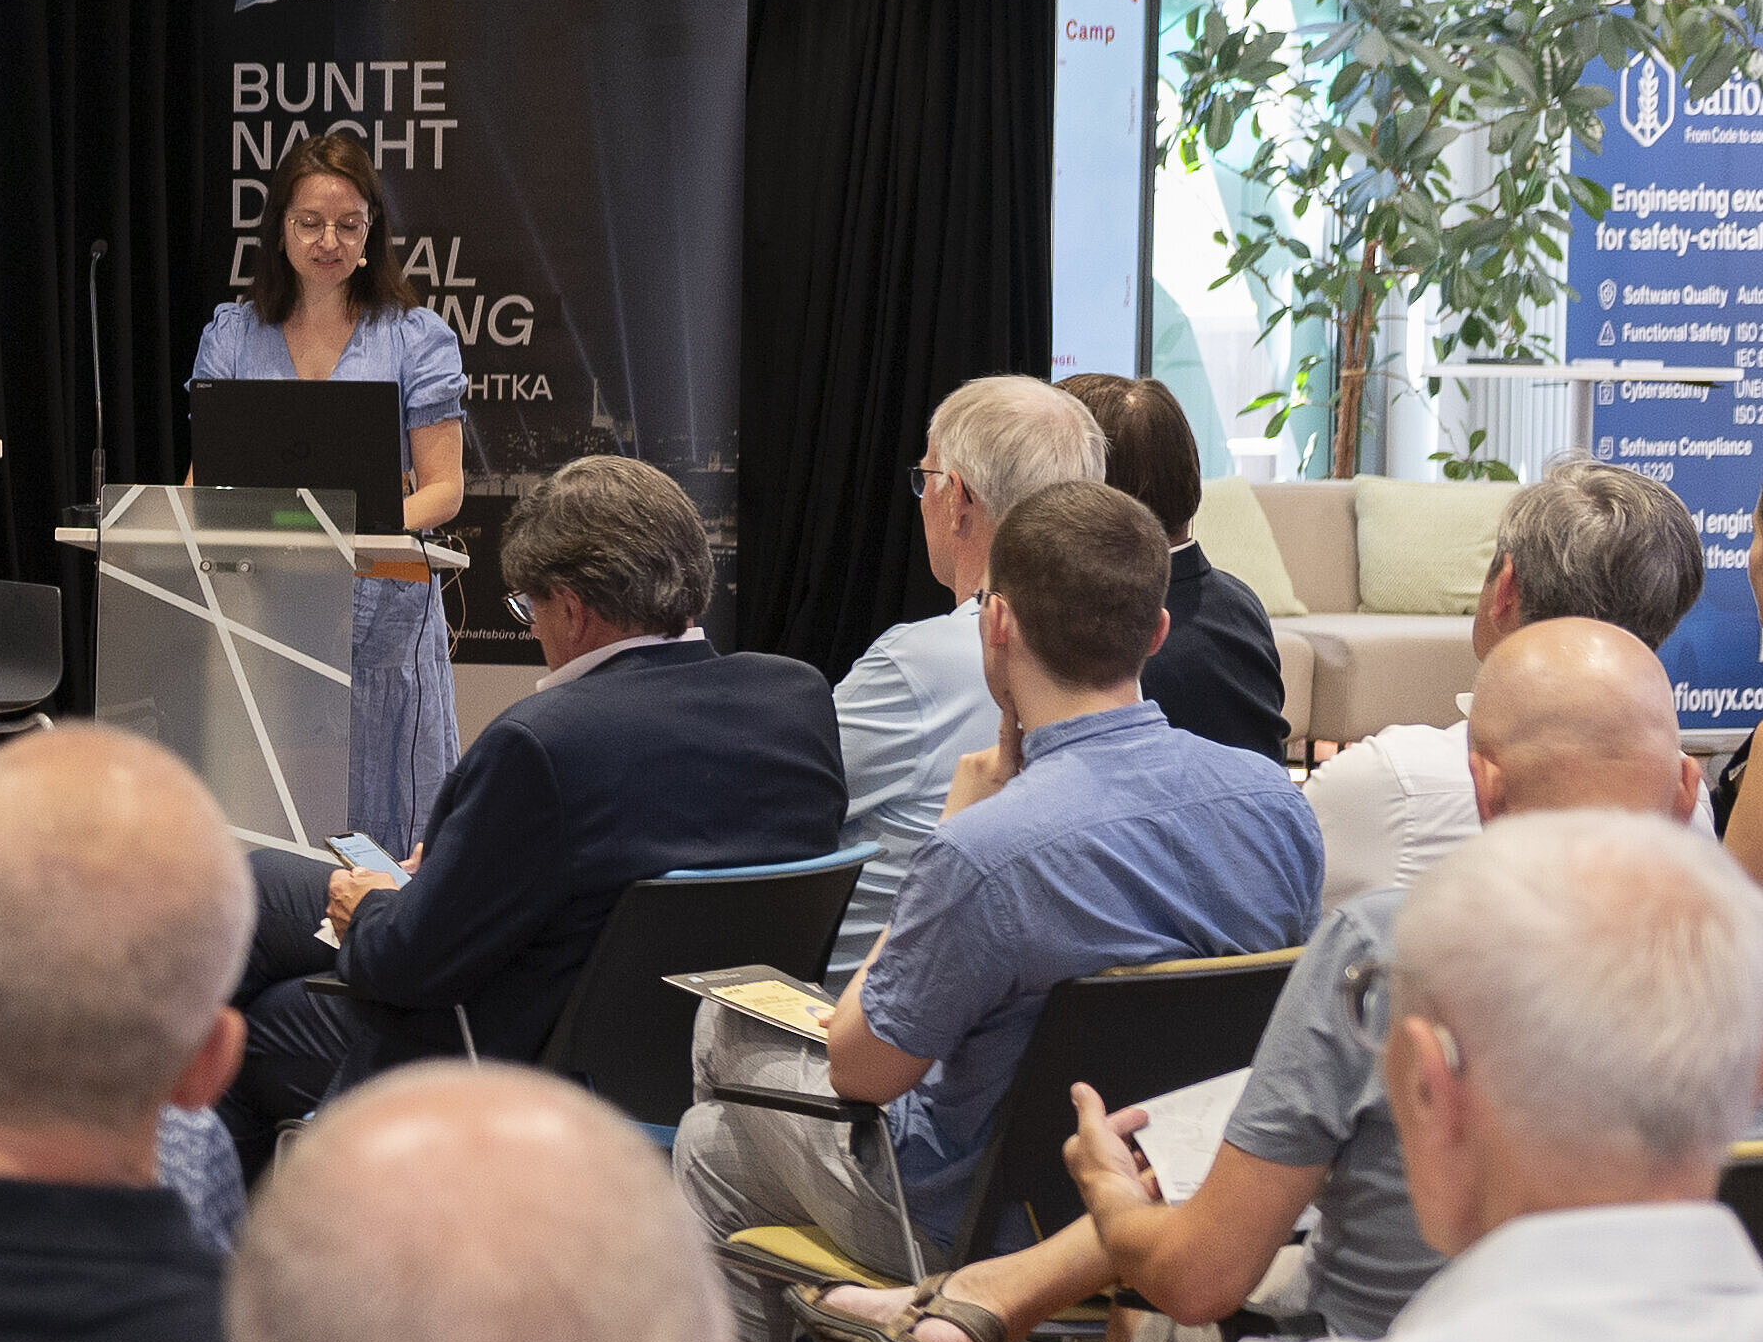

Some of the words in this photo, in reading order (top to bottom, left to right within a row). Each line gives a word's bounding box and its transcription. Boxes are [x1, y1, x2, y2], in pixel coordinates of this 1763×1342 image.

[1066, 20, 1115, 46] Camp
[233, 61, 446, 112] BUNTE
[1683, 125, 1711, 144] From
[1711, 125, 1738, 144] Code
[1738, 127, 1750, 144] to
[1611, 182, 1729, 219] Engineering
[1596, 221, 1626, 251] for
[1628, 220, 1763, 257] safety-critical
[1622, 284, 1681, 306] Software
[1681, 284, 1729, 309] Quality
[1621, 321, 1688, 343] Functional
[1688, 322, 1731, 346] Safety
[1734, 321, 1759, 343] ISO
[1734, 347, 1757, 369] IEC
[1731, 404, 1756, 426] ISO
[1618, 436, 1677, 457] Software
[1678, 436, 1753, 460] Compliance
[1705, 507, 1754, 540] engin
[1675, 681, 1763, 718] fionyx.co
